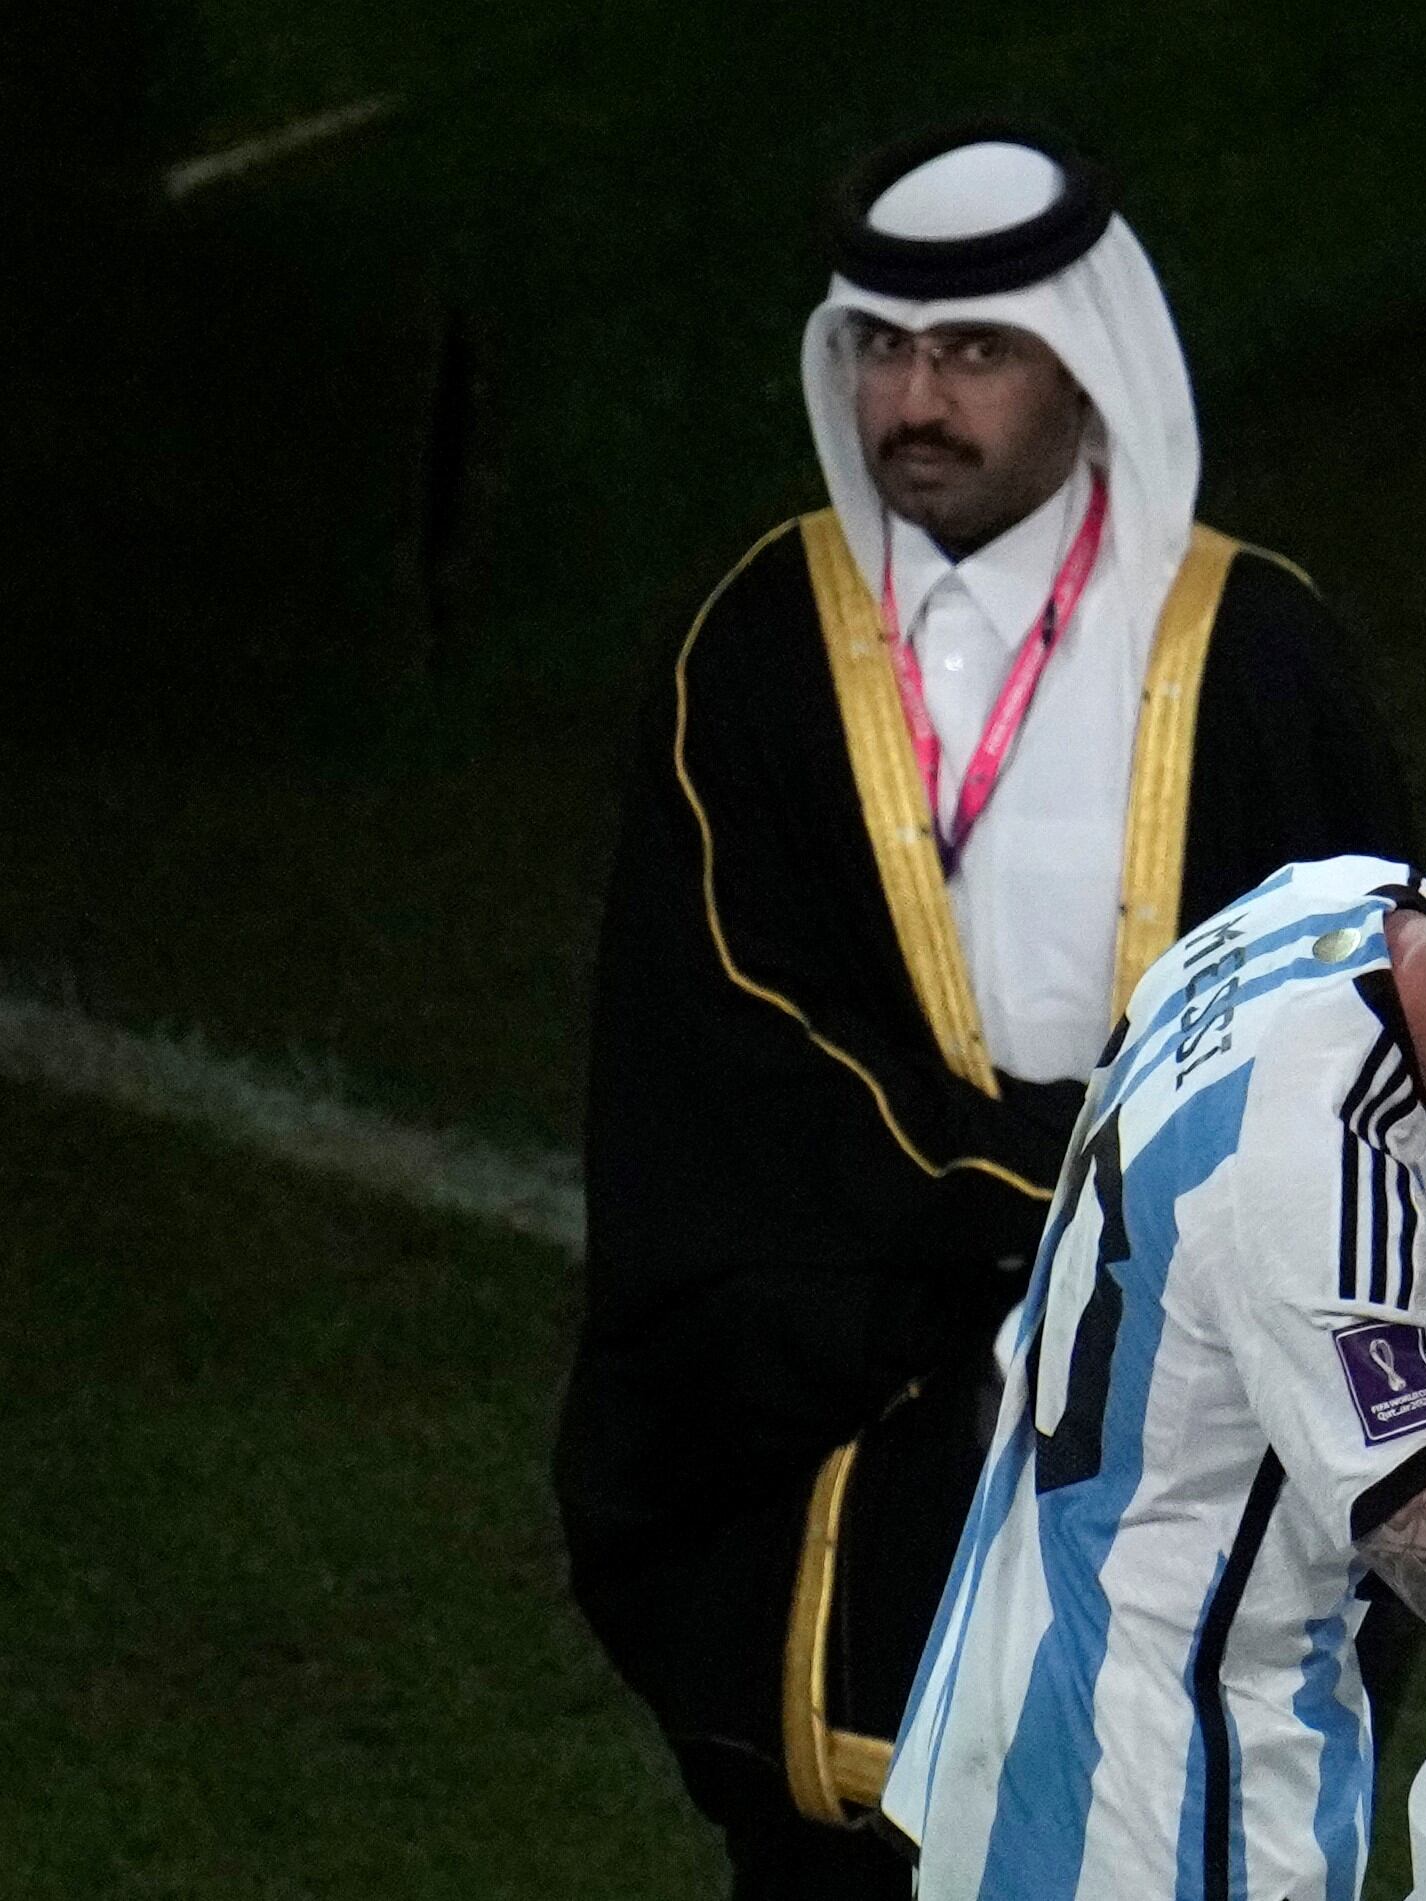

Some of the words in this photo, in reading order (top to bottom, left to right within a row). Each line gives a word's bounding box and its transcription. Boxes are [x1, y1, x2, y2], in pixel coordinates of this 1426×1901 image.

[1175, 912, 1250, 1092] MESSI
[1371, 1402, 1390, 1413] FIFA
[1389, 1394, 1412, 1406] WORLD
